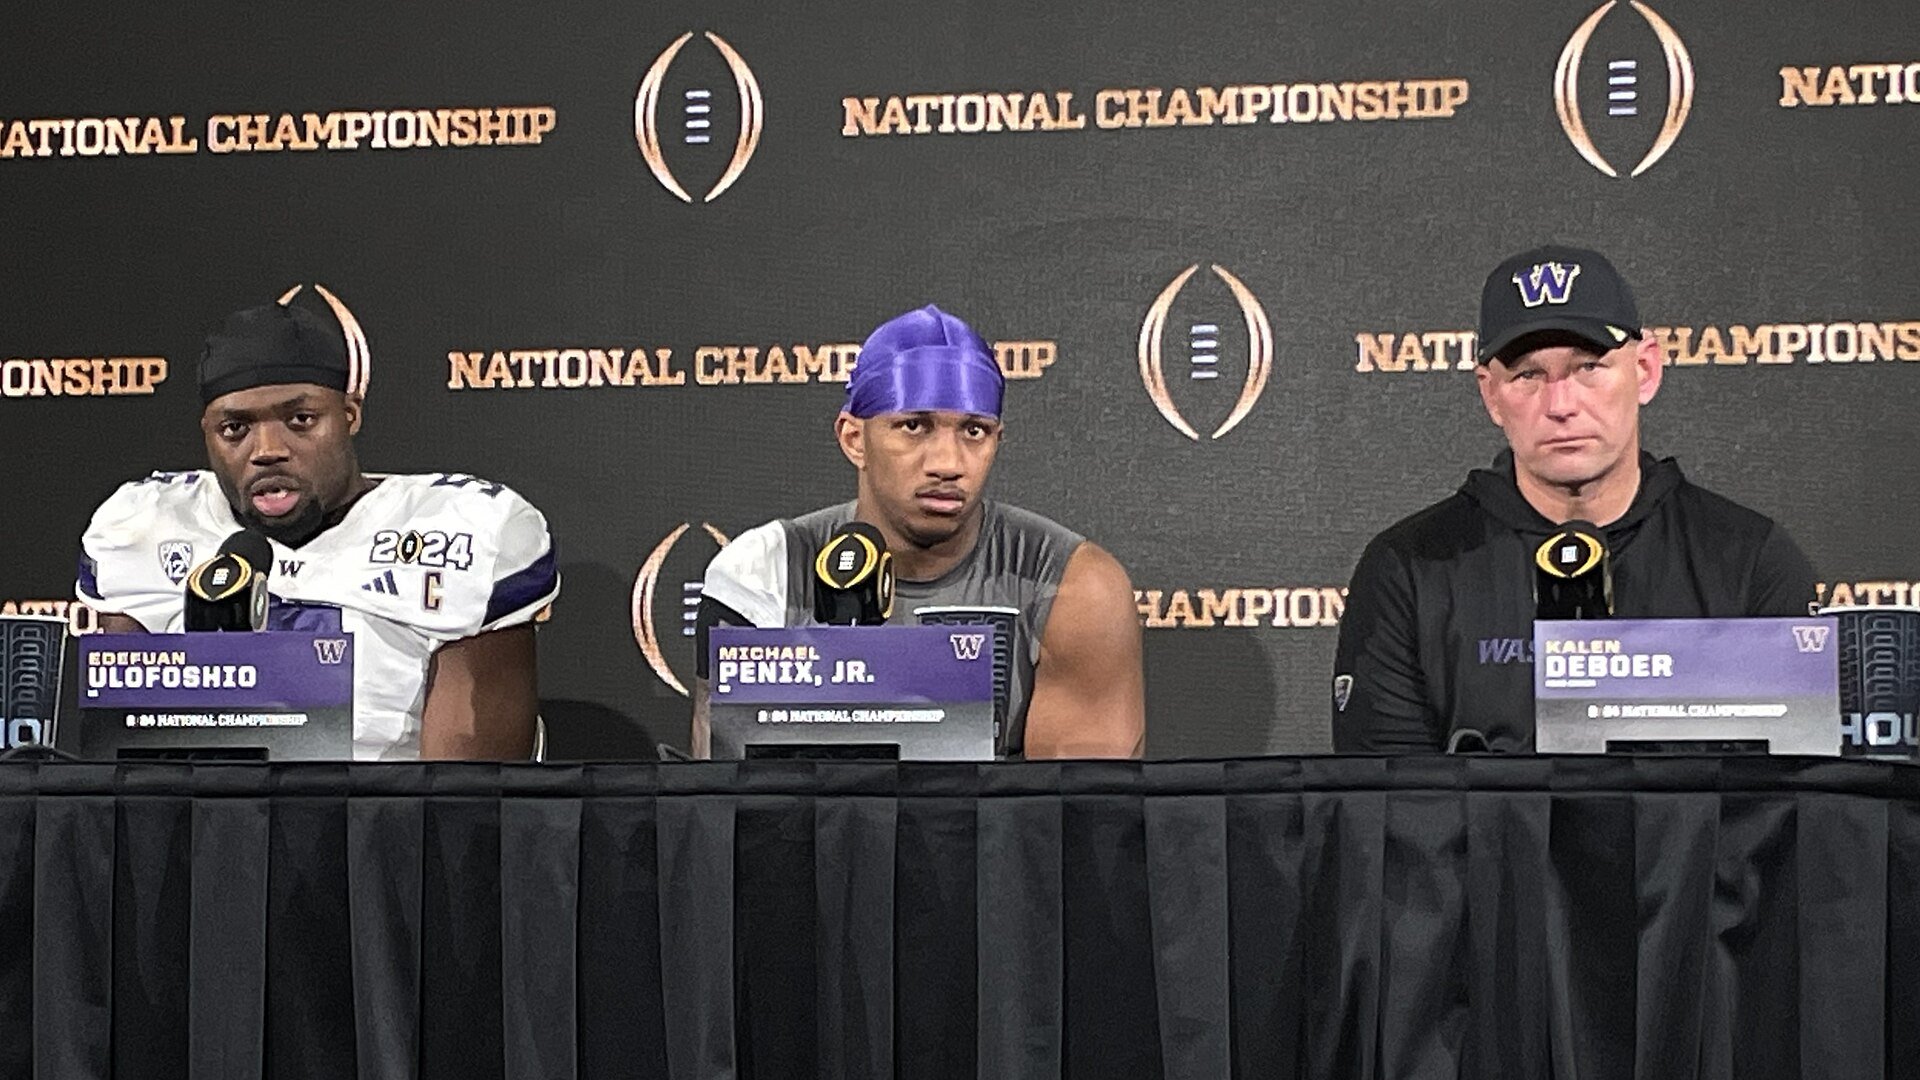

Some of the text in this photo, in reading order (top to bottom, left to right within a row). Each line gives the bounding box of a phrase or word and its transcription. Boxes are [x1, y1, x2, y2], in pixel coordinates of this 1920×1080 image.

[842, 79, 1469, 136] NATIONAL CHAMPIONSHIP
[0, 107, 557, 158] ATIONAL CHAMPIONSHIP
[1512, 261, 1581, 308] W
[1355, 321, 1920, 371] NATI HAMPIONS
[0, 357, 168, 397] ONSHIP
[448, 349, 686, 390] NATIONAL
[279, 560, 305, 578] W
[422, 569, 444, 613] C
[1132, 585, 1349, 628] HAMPION
[313, 639, 347, 664] W
[949, 633, 985, 660] W
[1545, 640, 1621, 654] KALEN
[1792, 625, 1830, 652] W
[88, 651, 186, 666] EDEFUAN
[719, 647, 821, 661] MICHAEL
[1545, 654, 1673, 678] DEBOER
[88, 665, 257, 688] ULOFOSHIO
[719, 661, 875, 686] PENIX, JR.
